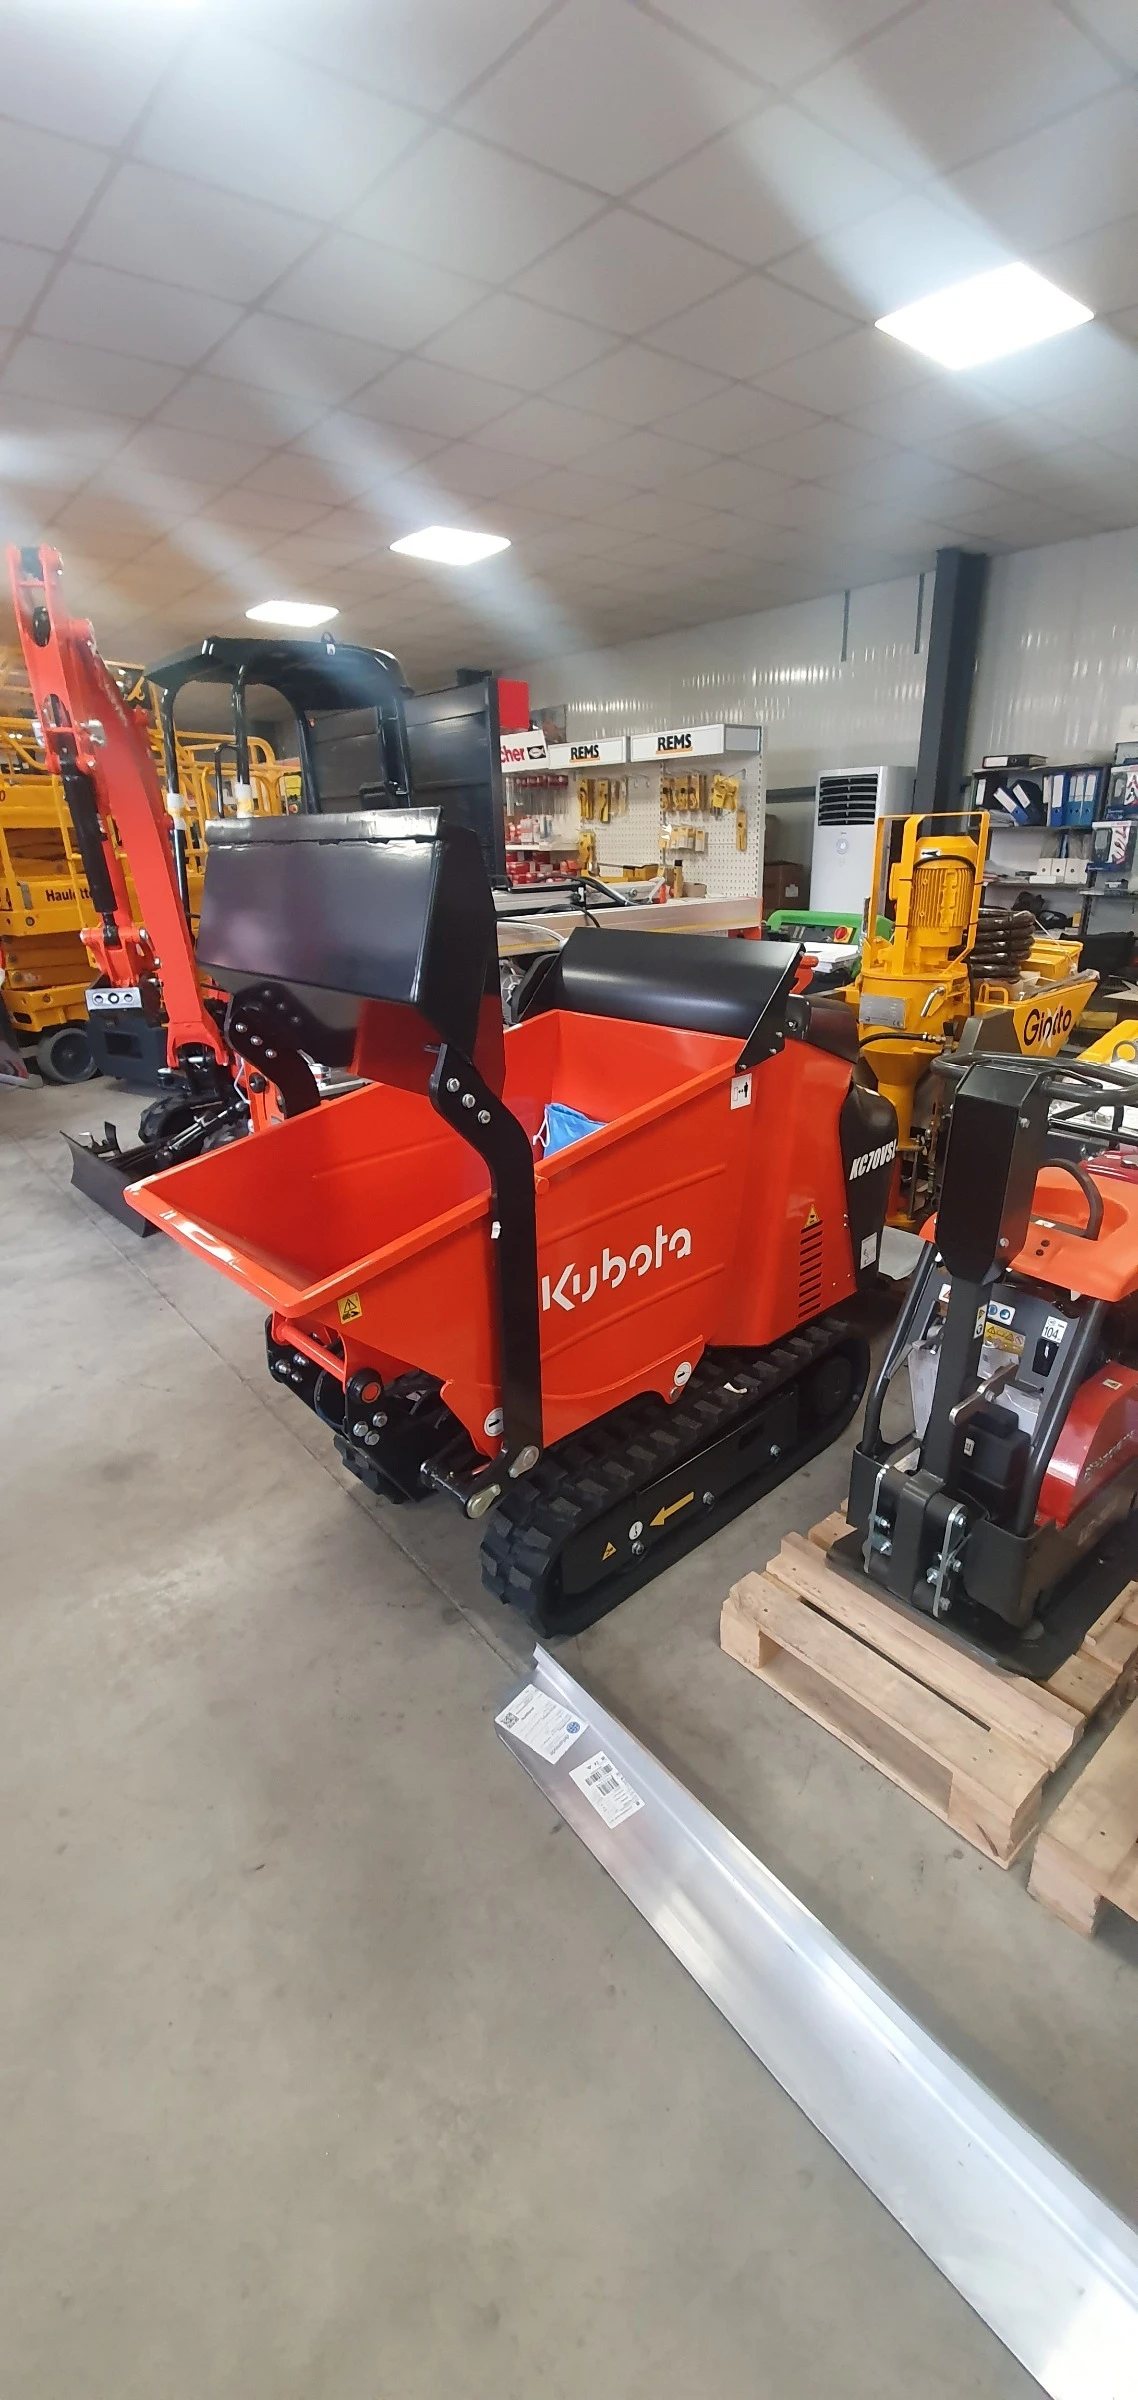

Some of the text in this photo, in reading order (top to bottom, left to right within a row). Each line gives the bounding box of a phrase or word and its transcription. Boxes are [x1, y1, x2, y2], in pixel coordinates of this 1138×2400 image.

[657, 733, 692, 751] REMS
[500, 745, 526, 763] cher
[571, 744, 599, 760] REMS
[45, 888, 92, 902] Haultt
[541, 1224, 691, 1312] Kubota
[1044, 1326, 1060, 1340] 104
